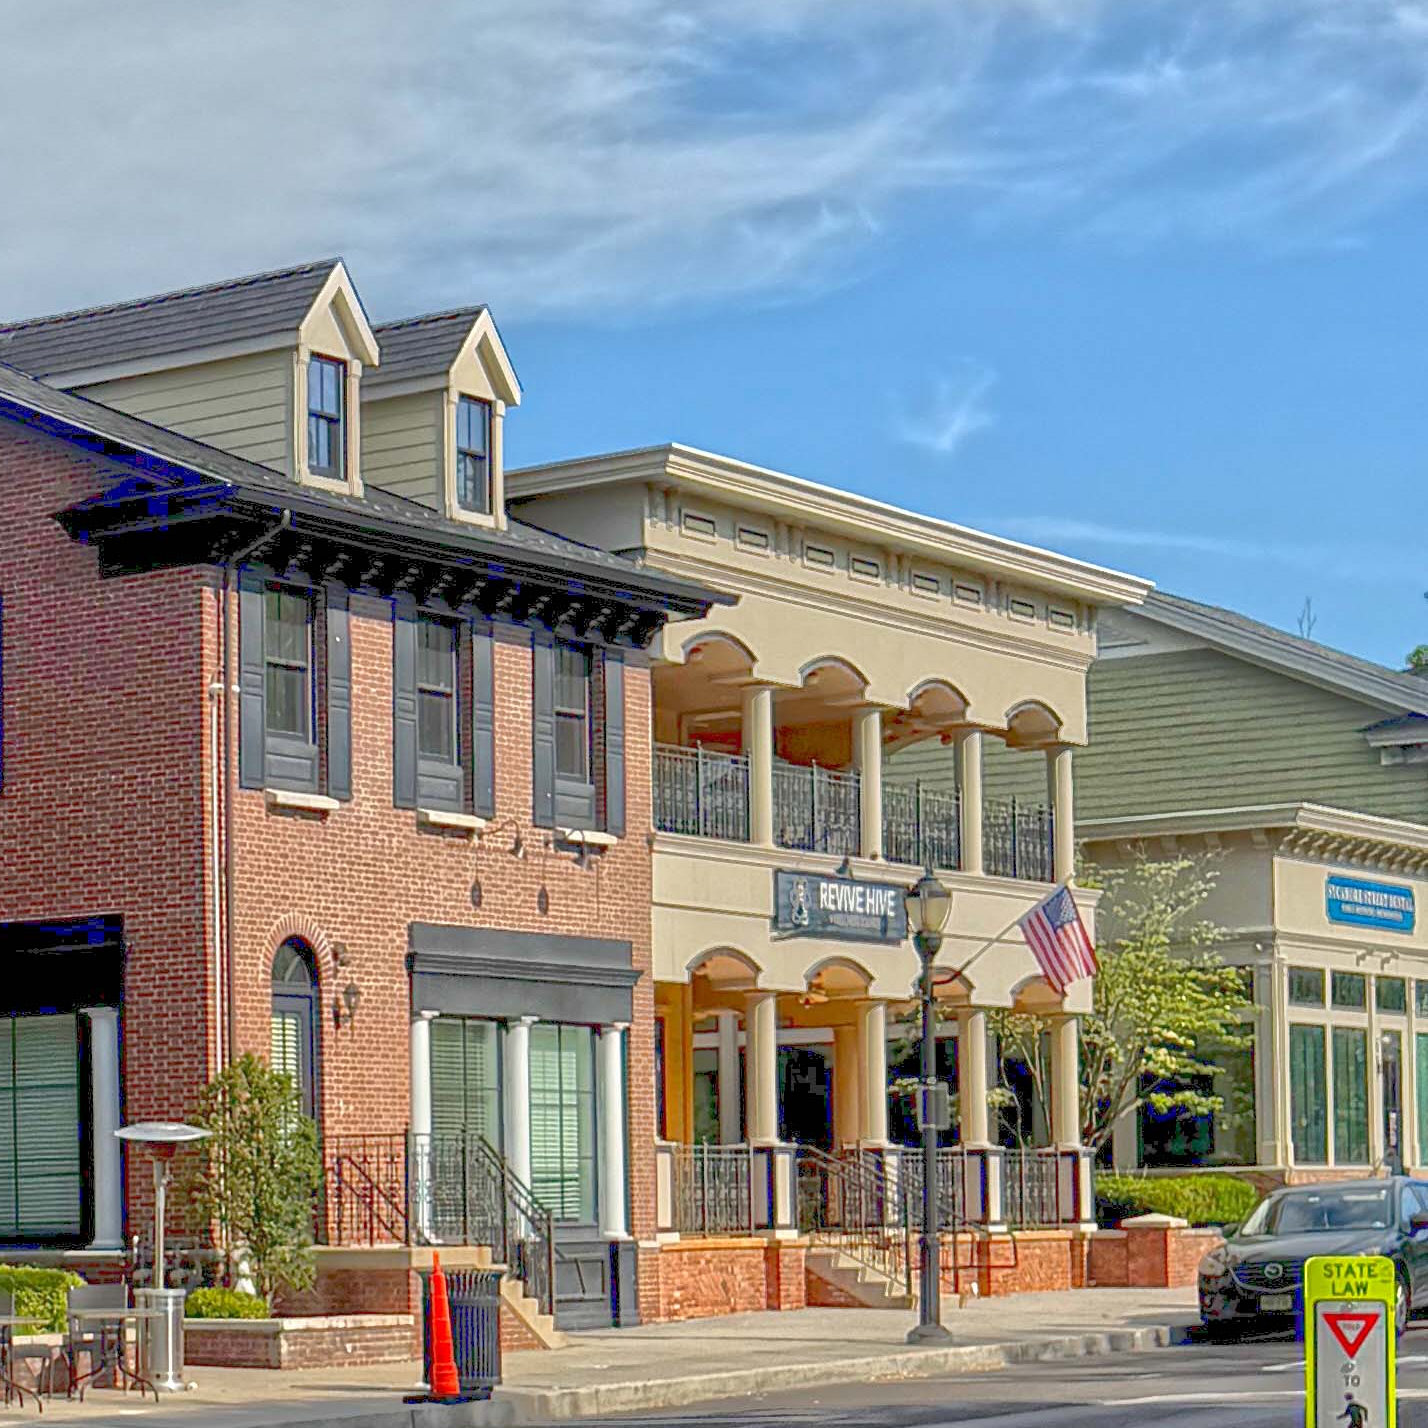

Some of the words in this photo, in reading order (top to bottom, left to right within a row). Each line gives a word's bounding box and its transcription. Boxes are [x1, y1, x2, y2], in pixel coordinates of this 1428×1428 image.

[819, 882, 865, 913] REVIVE
[866, 888, 896, 917] HIVE
[1323, 1263, 1378, 1279] STATE
[1332, 1280, 1369, 1297] LAW
[1344, 1374, 1361, 1388] TO
